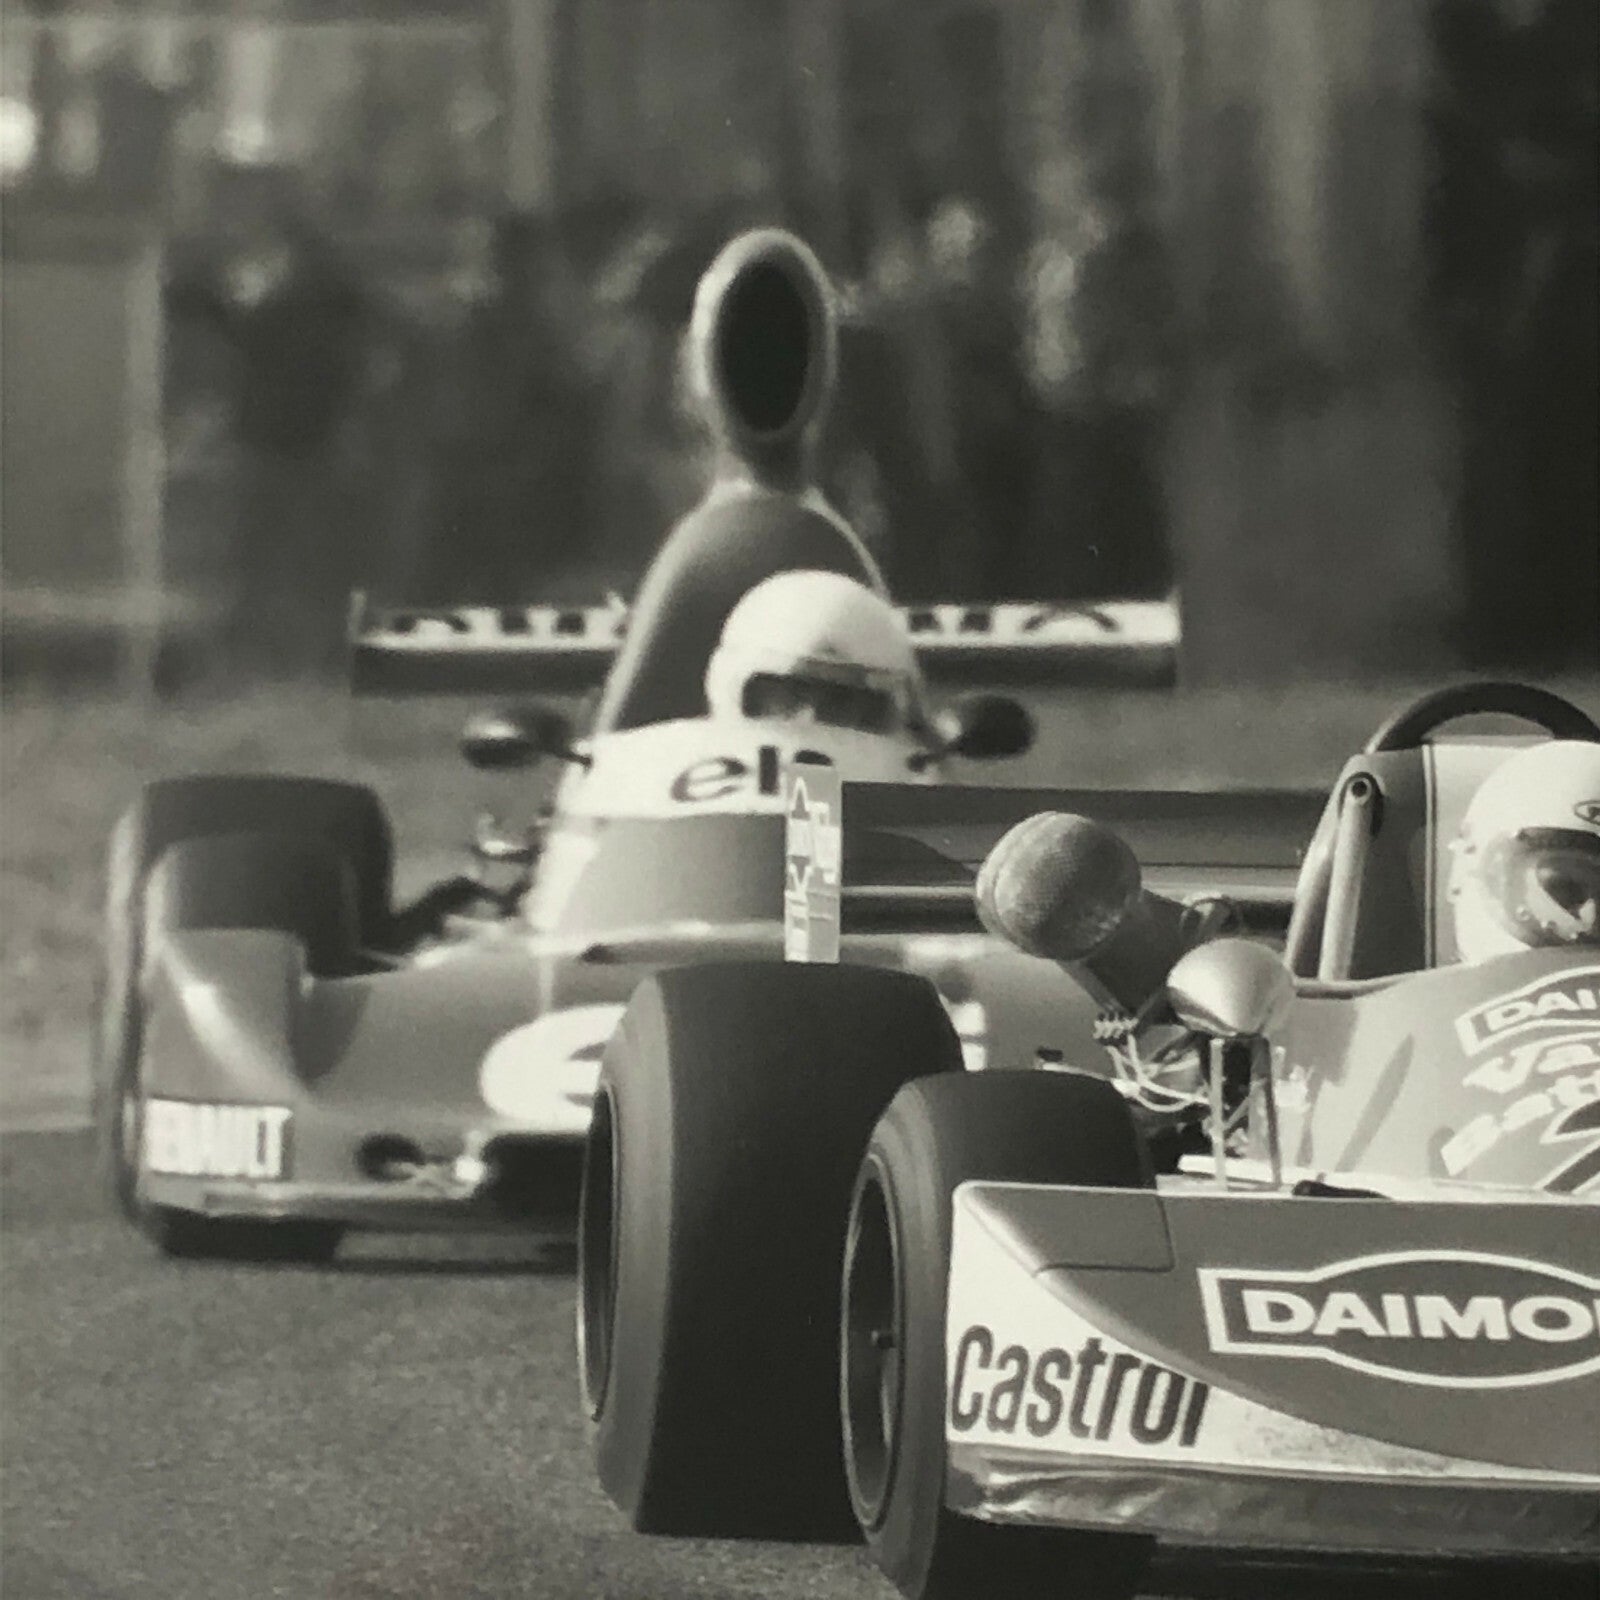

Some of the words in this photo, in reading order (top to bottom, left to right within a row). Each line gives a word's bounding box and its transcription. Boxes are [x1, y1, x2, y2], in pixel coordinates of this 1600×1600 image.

[1485, 988, 1600, 1032] DAI
[1241, 1289, 1600, 1343] DAIMO
[951, 1324, 1209, 1447] Castrol
